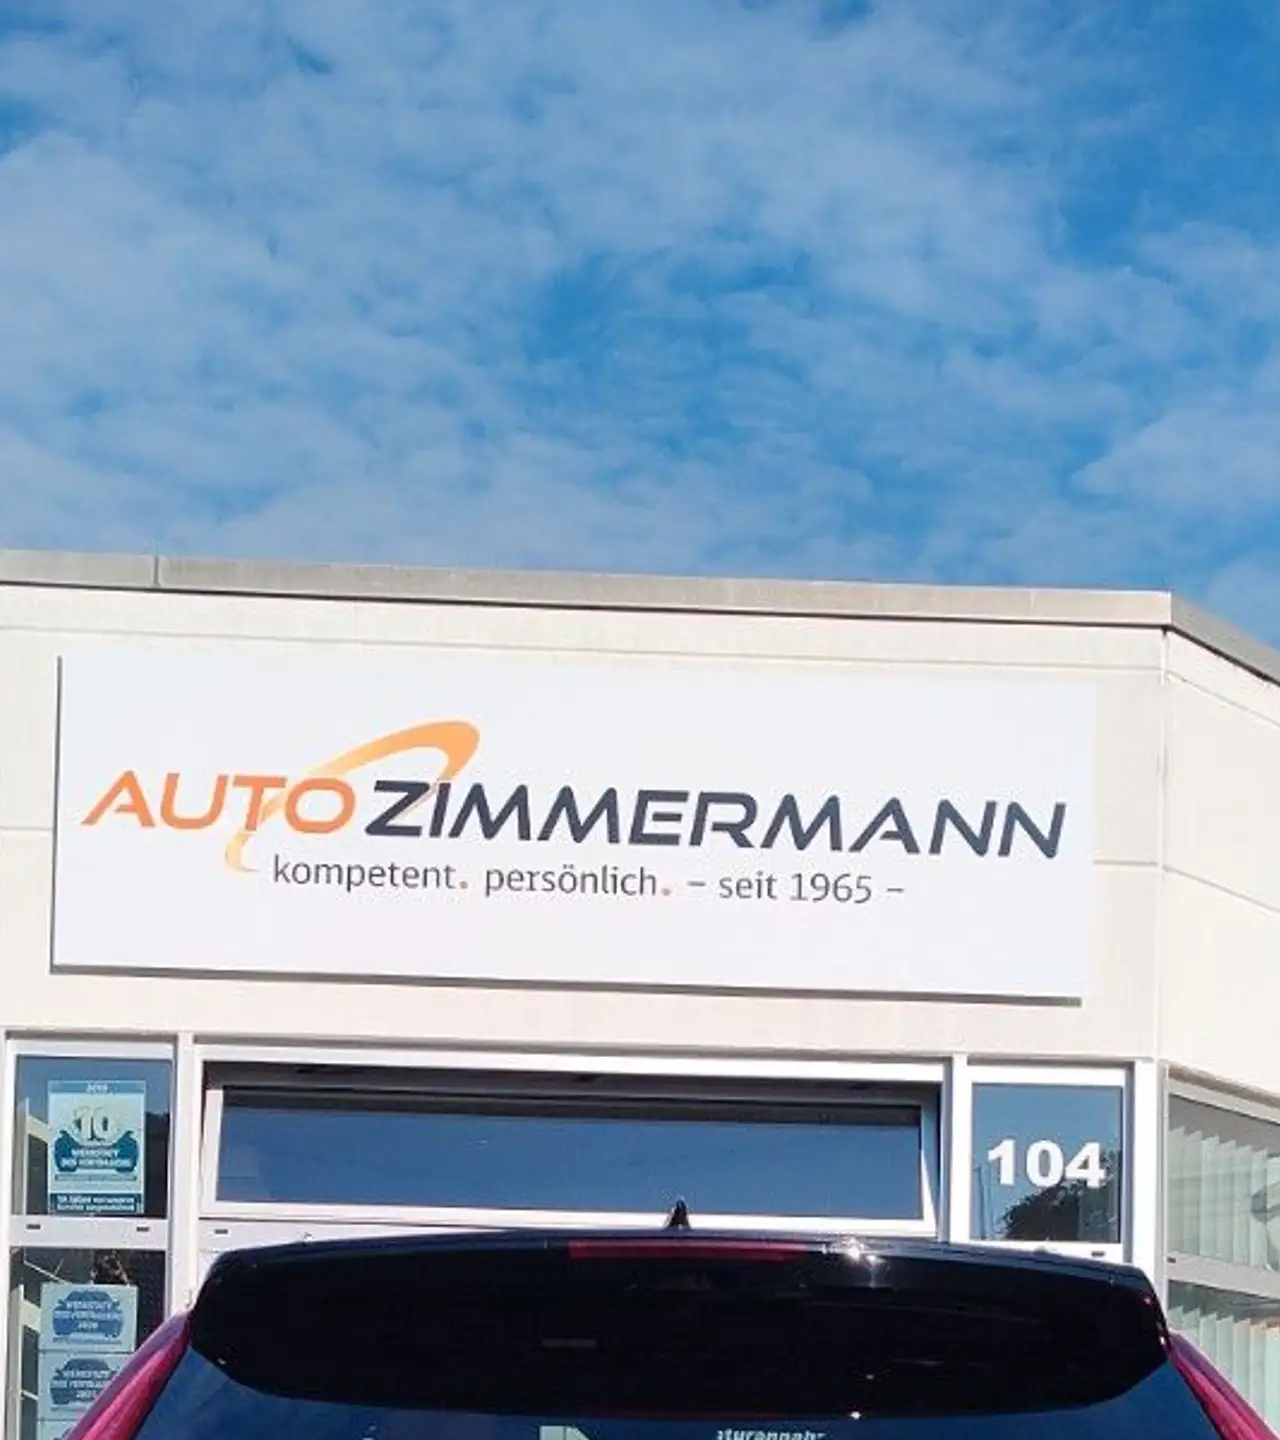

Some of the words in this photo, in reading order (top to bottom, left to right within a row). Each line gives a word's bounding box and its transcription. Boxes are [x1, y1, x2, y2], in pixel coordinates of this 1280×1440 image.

[81, 769, 356, 834] AUTO
[364, 778, 1067, 859] ZIMMERMANN
[272, 853, 468, 892] kompetent.
[484, 864, 672, 897] persönlich.
[718, 870, 778, 900] seit
[790, 871, 873, 904] 1965
[987, 1138, 1107, 1190] 104
